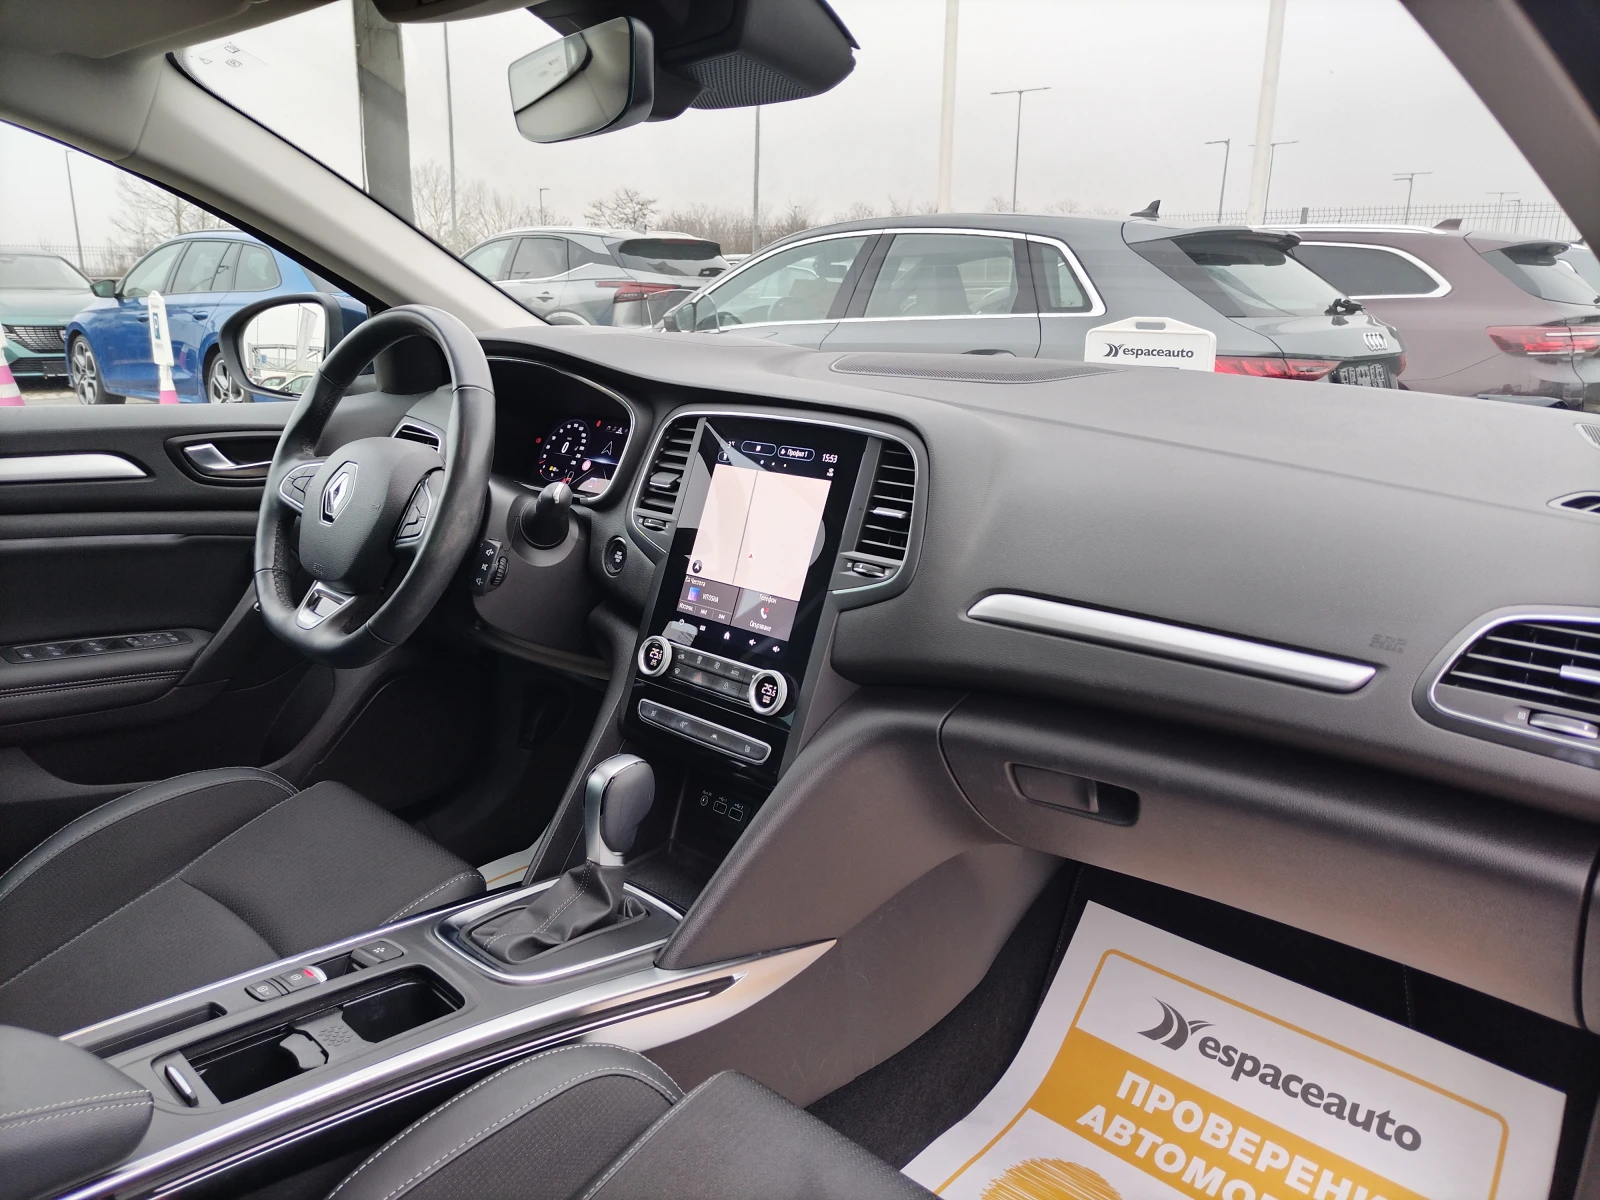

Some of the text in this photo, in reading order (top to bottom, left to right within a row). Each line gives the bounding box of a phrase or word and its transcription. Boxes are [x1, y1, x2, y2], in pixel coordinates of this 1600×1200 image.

[1122, 346, 1194, 359] espaceauto
[822, 454, 838, 464] 15:53
[1198, 1036, 1422, 1152] espaceauto
[1076, 1104, 1282, 1200] АВТОМО
